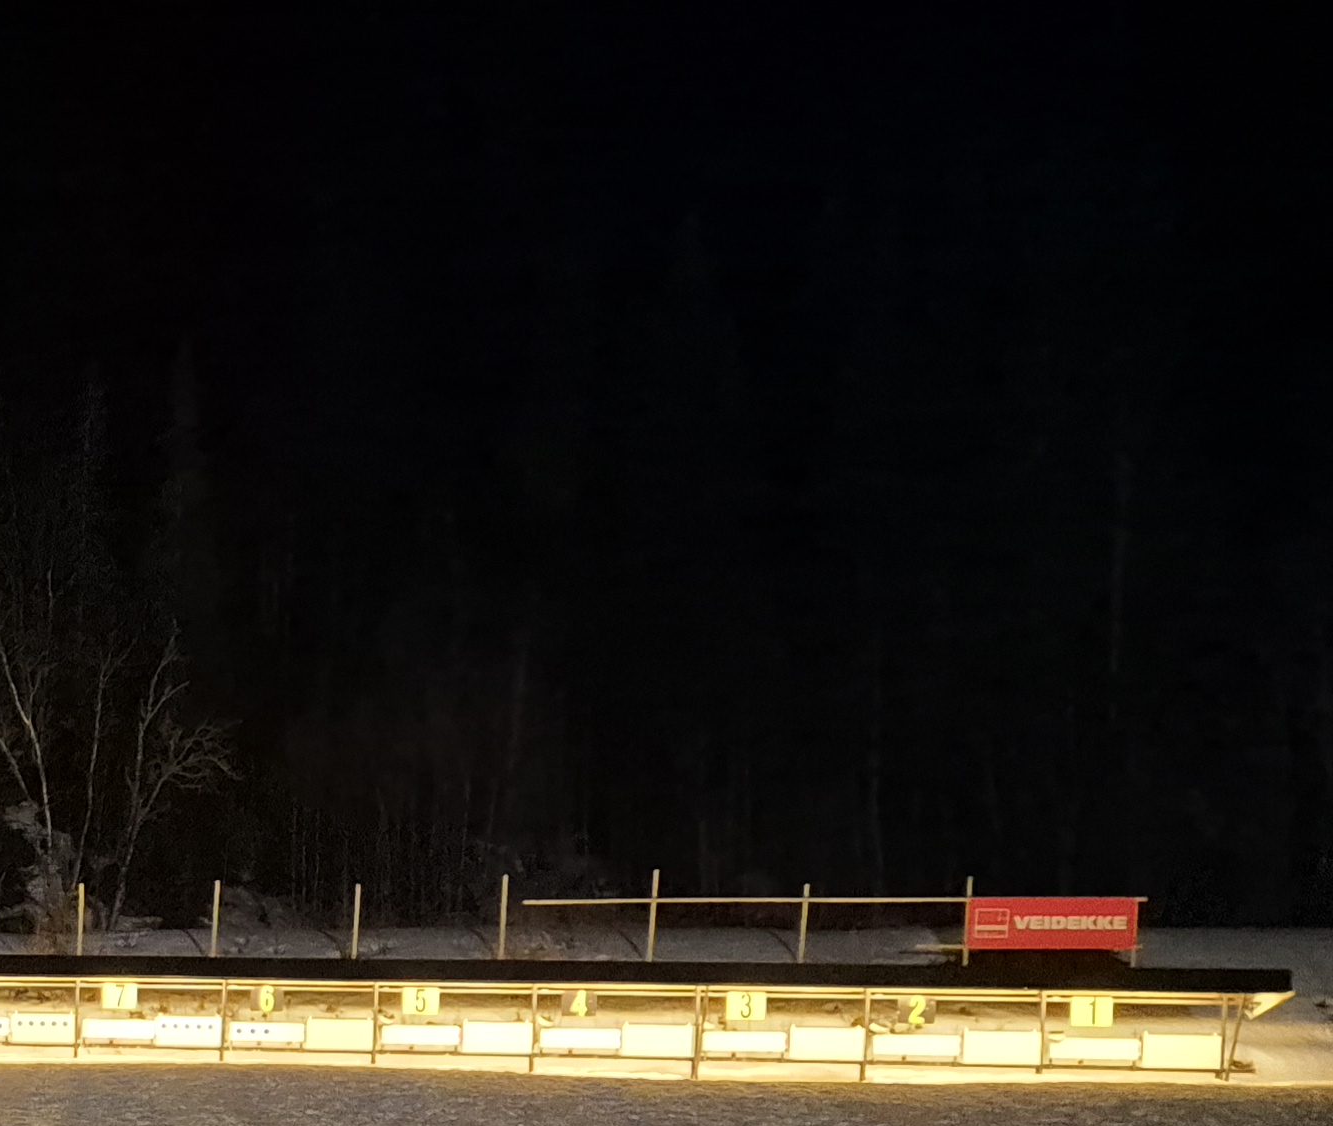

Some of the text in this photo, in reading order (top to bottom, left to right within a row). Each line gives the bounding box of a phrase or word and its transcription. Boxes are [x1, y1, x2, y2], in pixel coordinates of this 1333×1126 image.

[1014, 915, 1128, 930] VEIDEKKE
[115, 983, 125, 1008] 7
[261, 986, 274, 1012] 6
[415, 988, 426, 1013] 5
[570, 990, 588, 1016] 4
[740, 993, 752, 1019] 3
[909, 995, 926, 1024] 2
